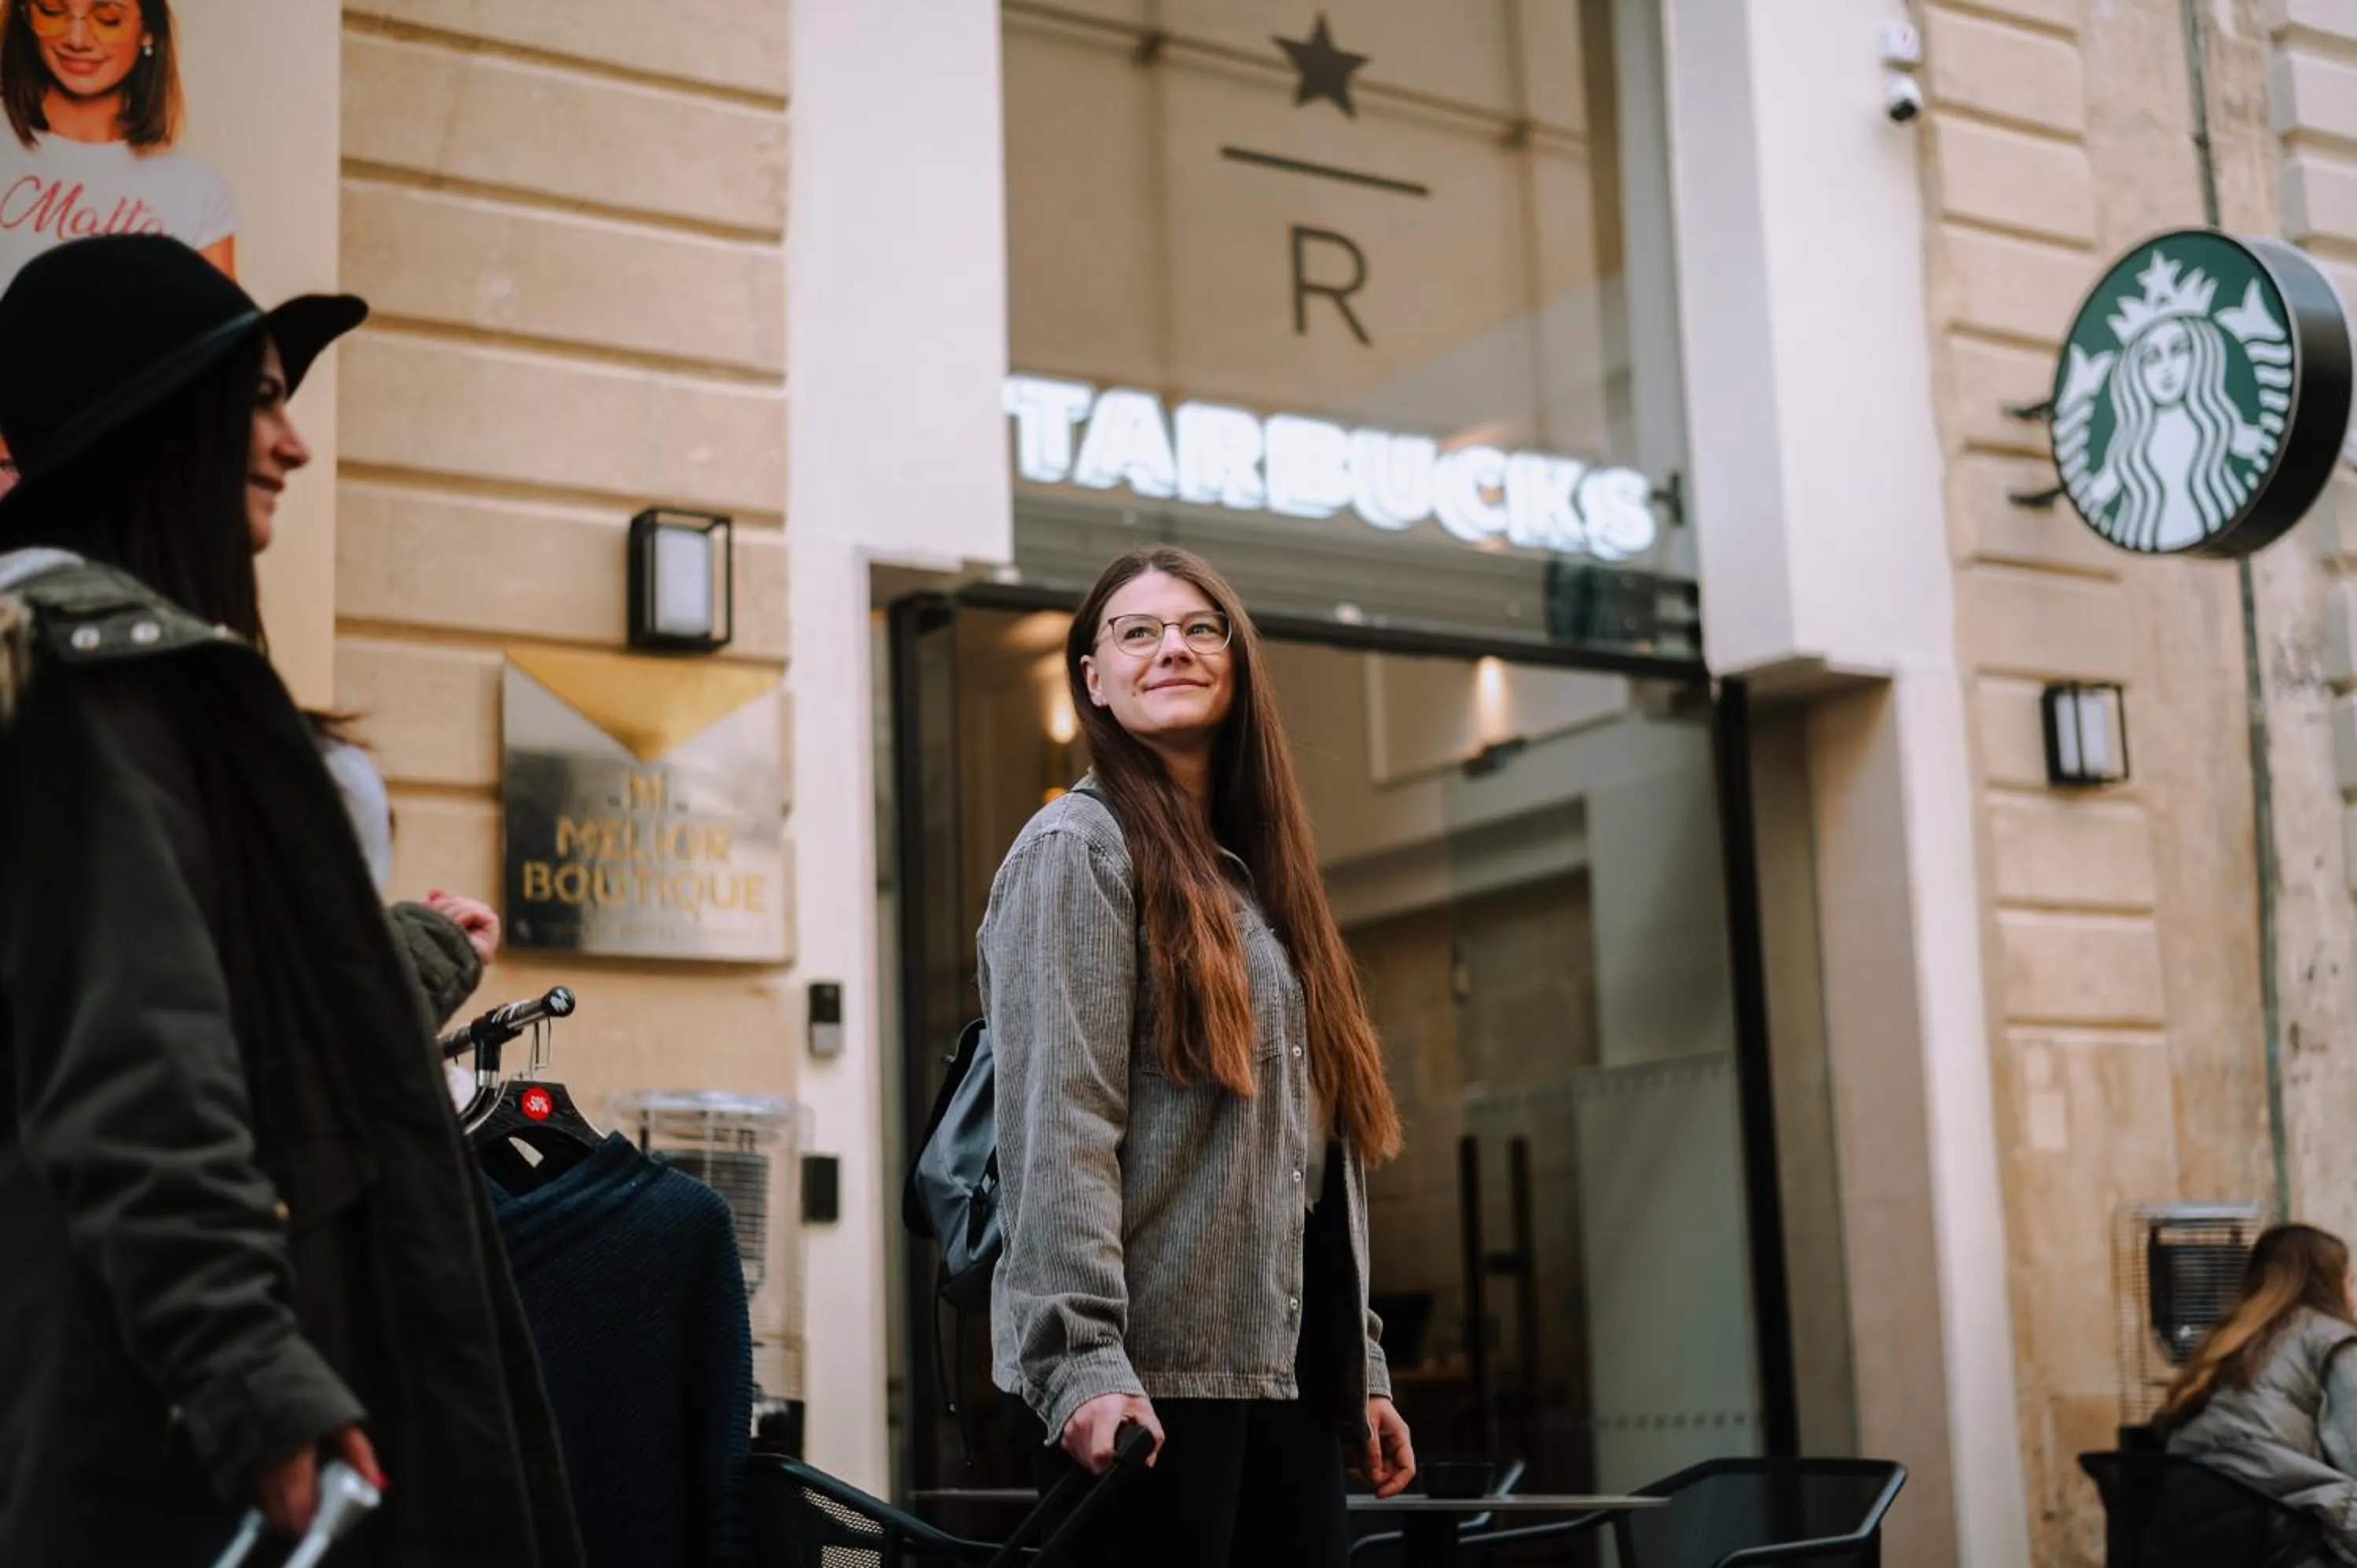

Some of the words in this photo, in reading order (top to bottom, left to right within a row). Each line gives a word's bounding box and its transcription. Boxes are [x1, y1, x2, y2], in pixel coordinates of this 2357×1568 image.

[1292, 225, 1371, 346] R
[555, 817, 734, 863] MELIOR
[522, 861, 766, 916] BOUTIQUE
